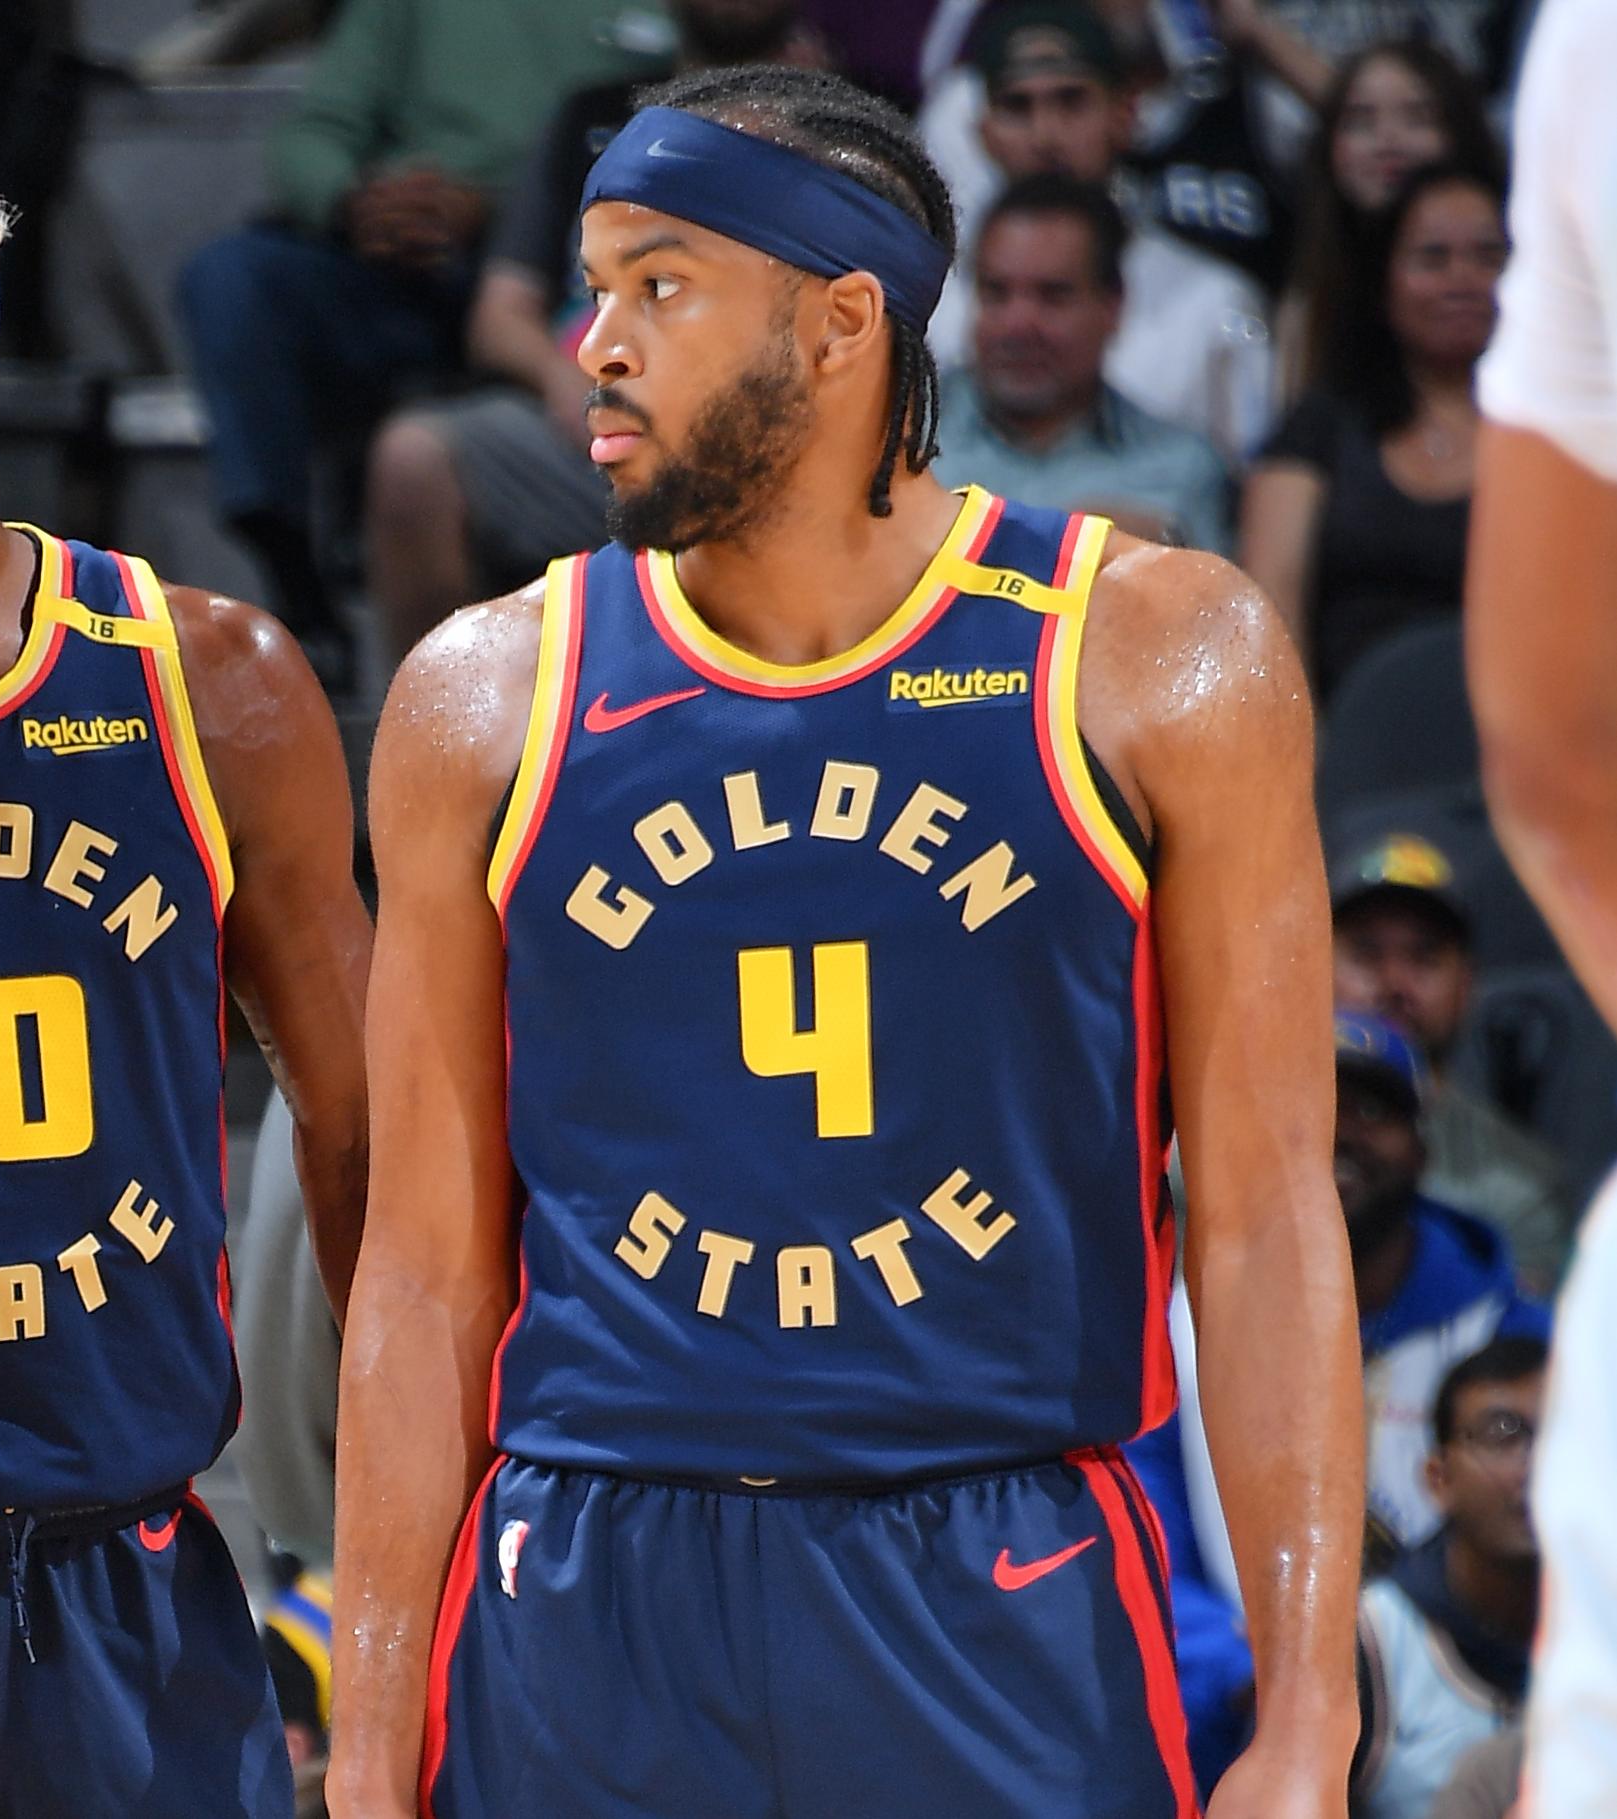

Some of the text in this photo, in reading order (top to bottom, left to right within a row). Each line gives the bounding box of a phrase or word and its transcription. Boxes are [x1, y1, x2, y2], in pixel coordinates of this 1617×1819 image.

[993, 574, 1026, 597] 16
[89, 617, 115, 638] 16
[889, 667, 1028, 701] Rakuten
[22, 715, 149, 750] Rakuten
[564, 758, 1038, 951] GOLDEN
[736, 939, 874, 1139] 4
[613, 1166, 1018, 1330] STATE
